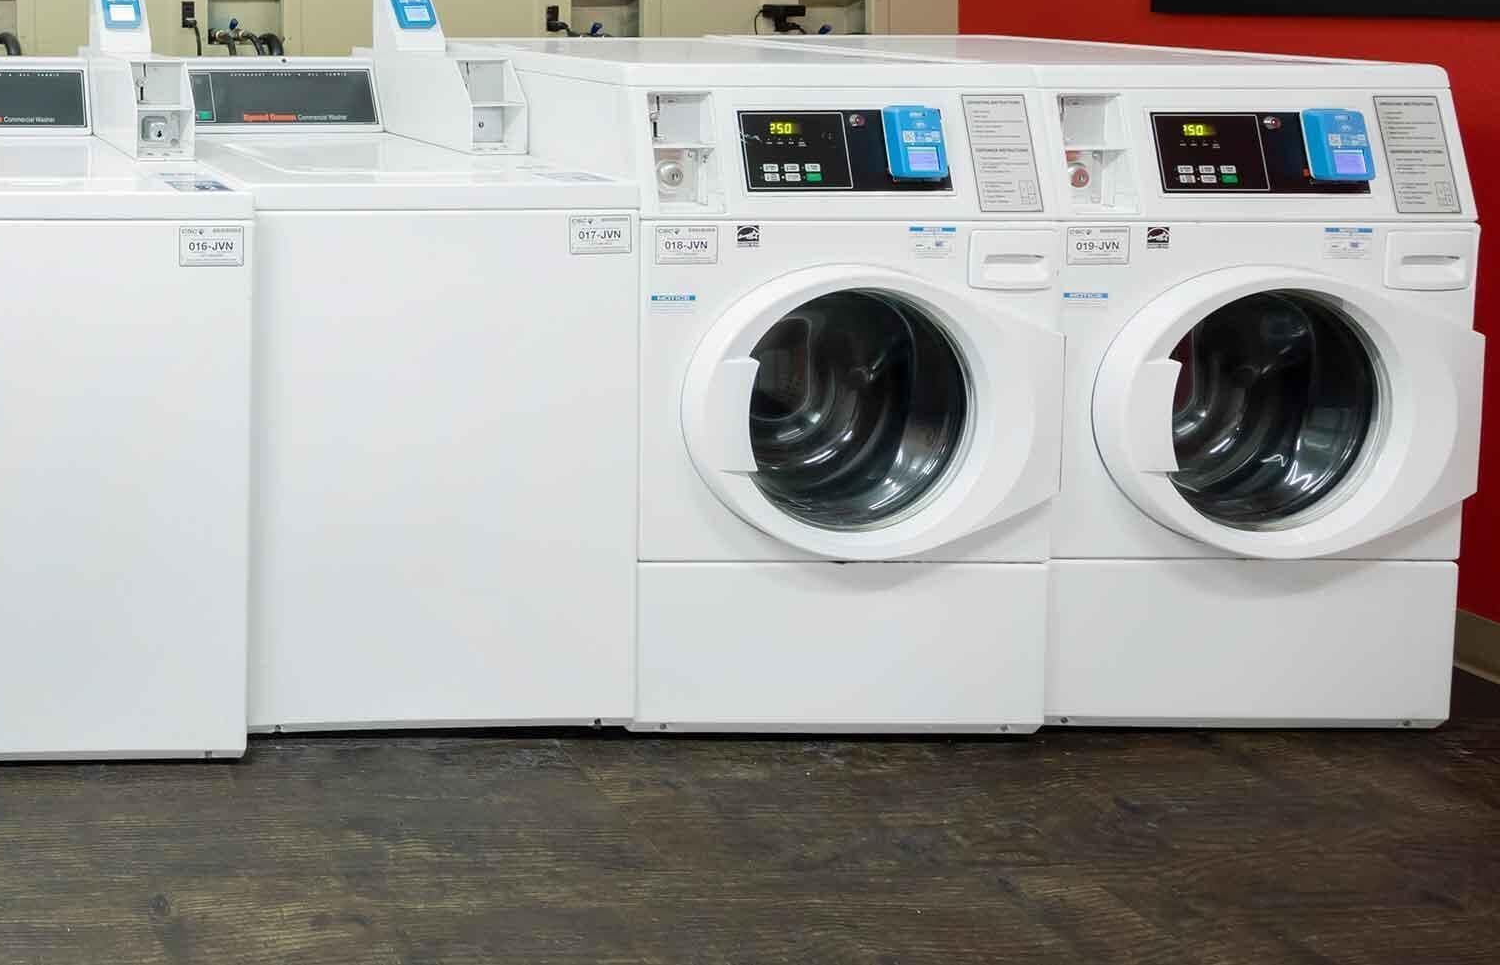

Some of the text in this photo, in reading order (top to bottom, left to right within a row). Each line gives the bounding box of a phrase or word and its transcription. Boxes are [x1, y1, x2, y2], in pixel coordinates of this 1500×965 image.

[578, 230, 621, 239] 017-JVN
[665, 241, 708, 250] 018-JVN
[1076, 242, 1120, 251] 019-JVN
